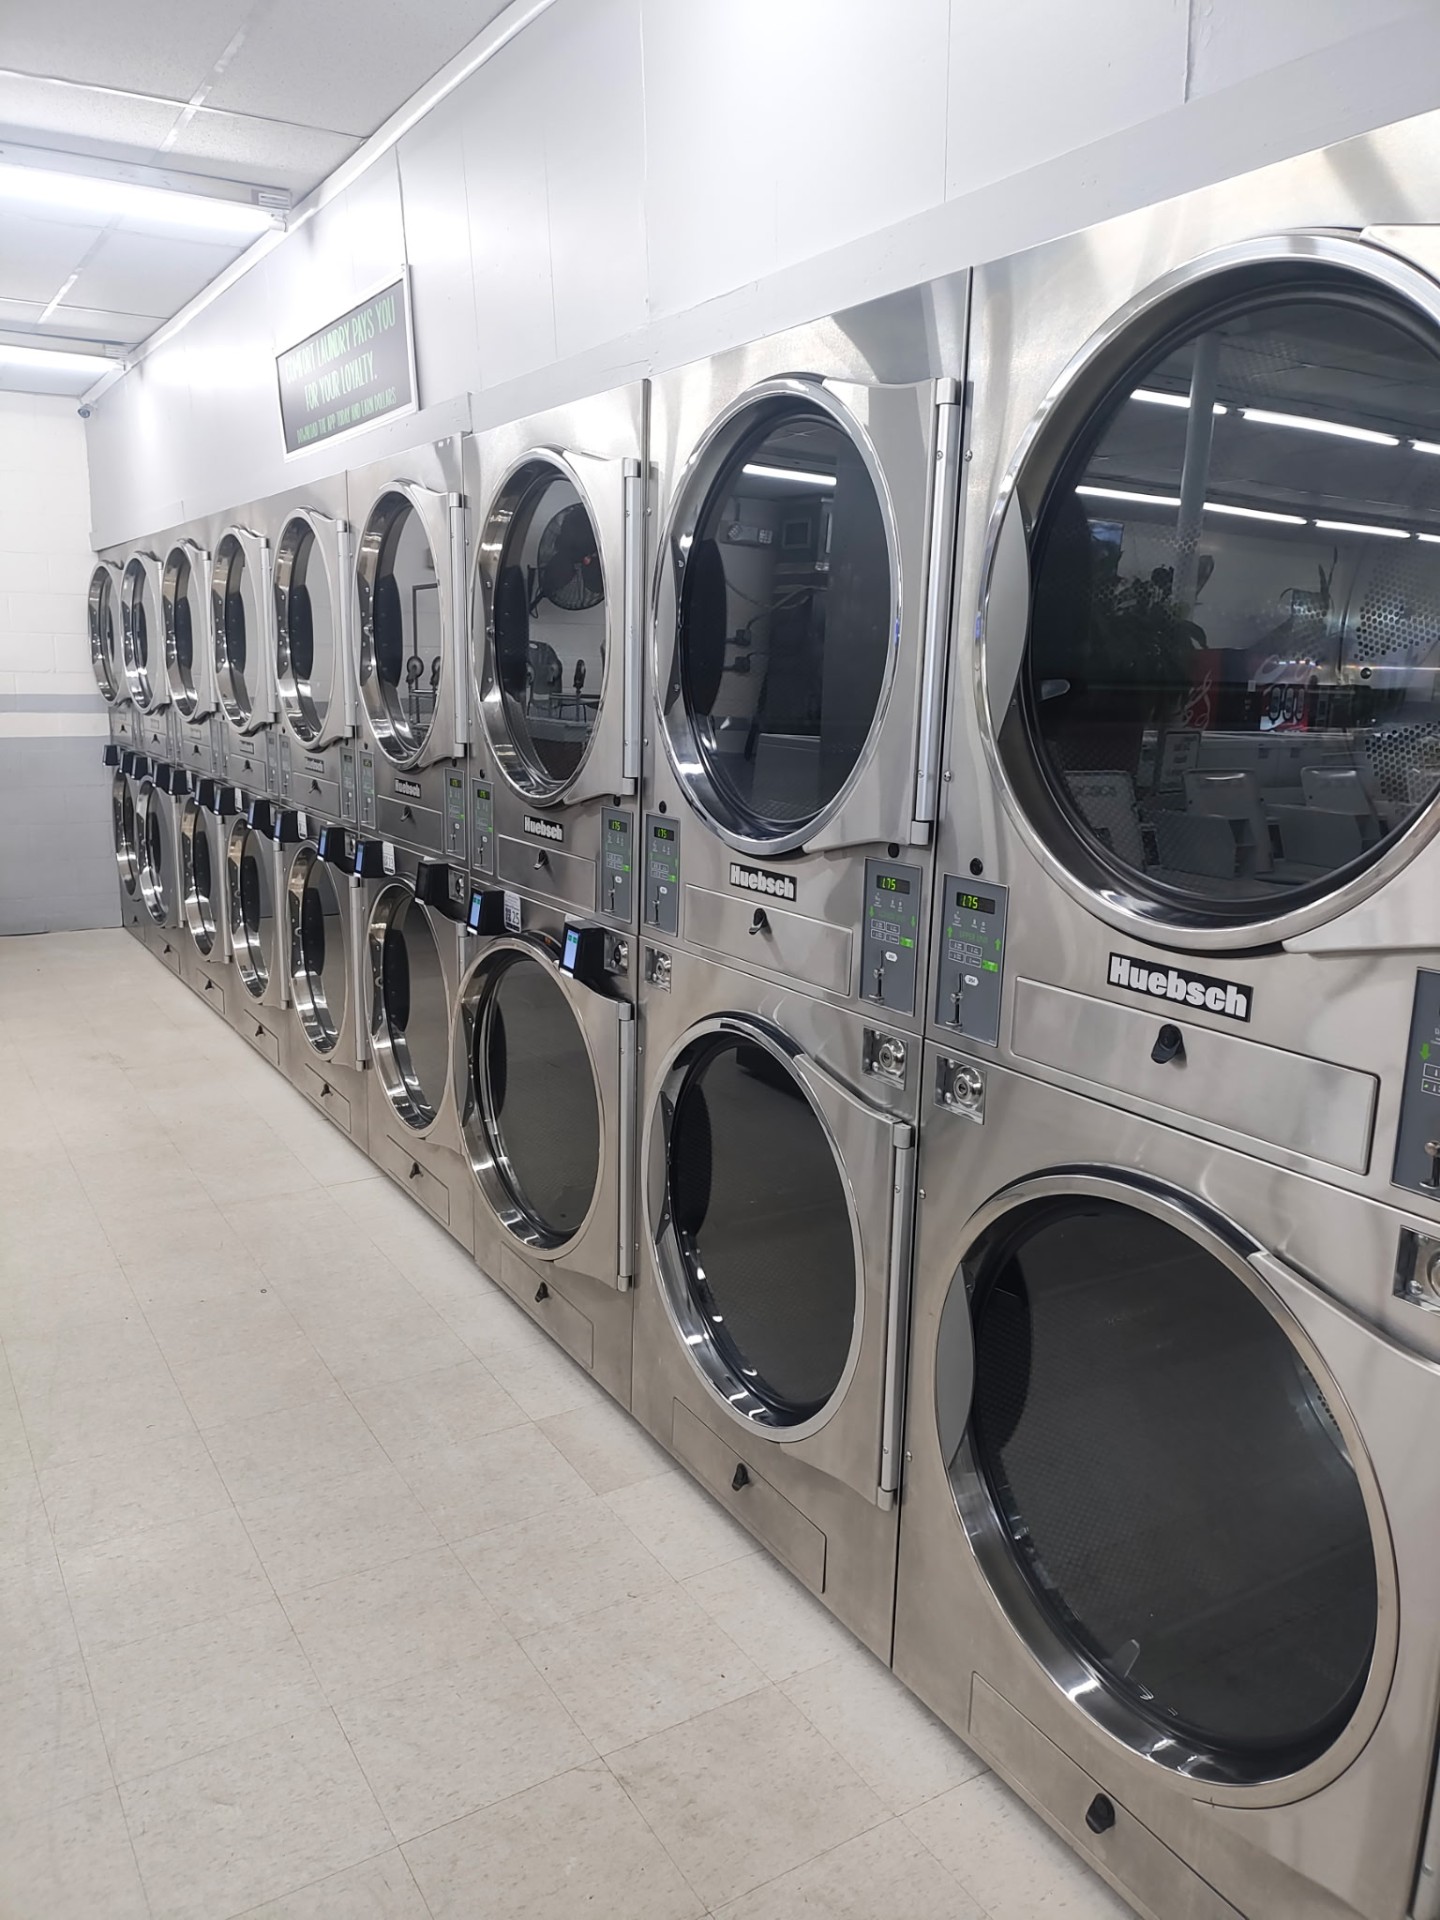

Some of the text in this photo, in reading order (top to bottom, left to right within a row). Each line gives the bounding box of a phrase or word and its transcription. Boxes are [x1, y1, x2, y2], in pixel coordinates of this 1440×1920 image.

[316, 322, 351, 367] LAUNDRY
[352, 308, 374, 347] PAYS
[375, 295, 396, 334] YOU
[304, 351, 378, 411] FOR YOUR LOYALTY.
[524, 816, 563, 841] Huebsch
[730, 865, 794, 899] Huebsch
[511, 910, 520, 925] 25
[1109, 955, 1247, 1018] Huebsch
